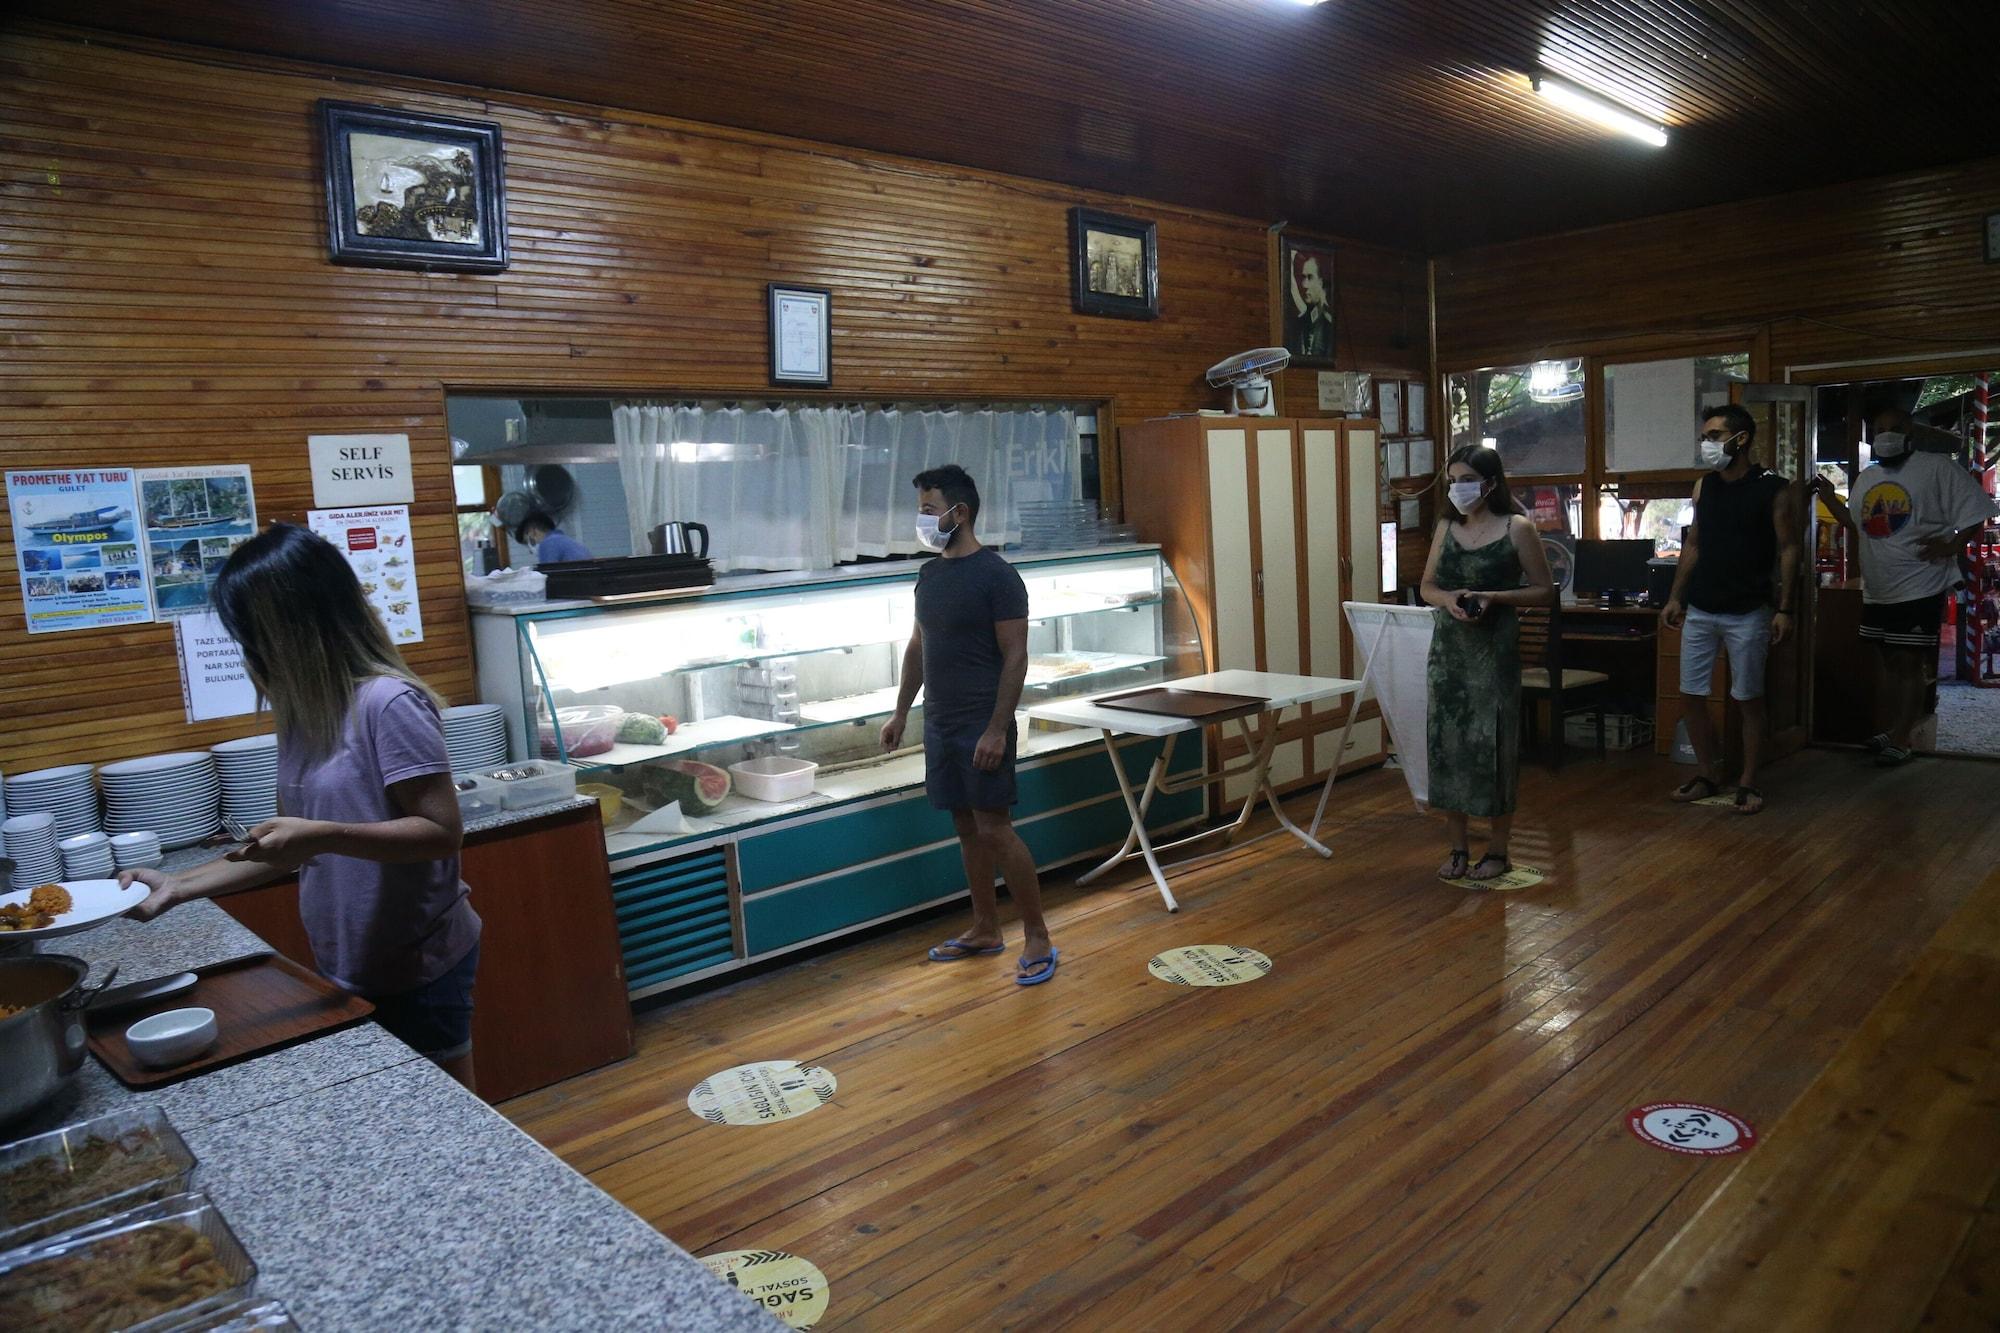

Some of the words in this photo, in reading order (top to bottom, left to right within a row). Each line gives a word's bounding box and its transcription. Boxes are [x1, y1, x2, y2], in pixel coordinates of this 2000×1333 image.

[339, 447, 383, 460] SELF
[12, 474, 72, 486] PROMETHE
[75, 473, 95, 484] YAT
[99, 471, 128, 483] TURU
[331, 464, 394, 481] SERVİS
[52, 532, 108, 544] Olympos
[195, 638, 215, 646] TAZE
[196, 648, 240, 658] PORTAKAL
[204, 662, 222, 670] NAR
[205, 673, 245, 683] BULUNUR
[1691, 1127, 1720, 1139] mt
[757, 1276, 809, 1293] SOSYAL
